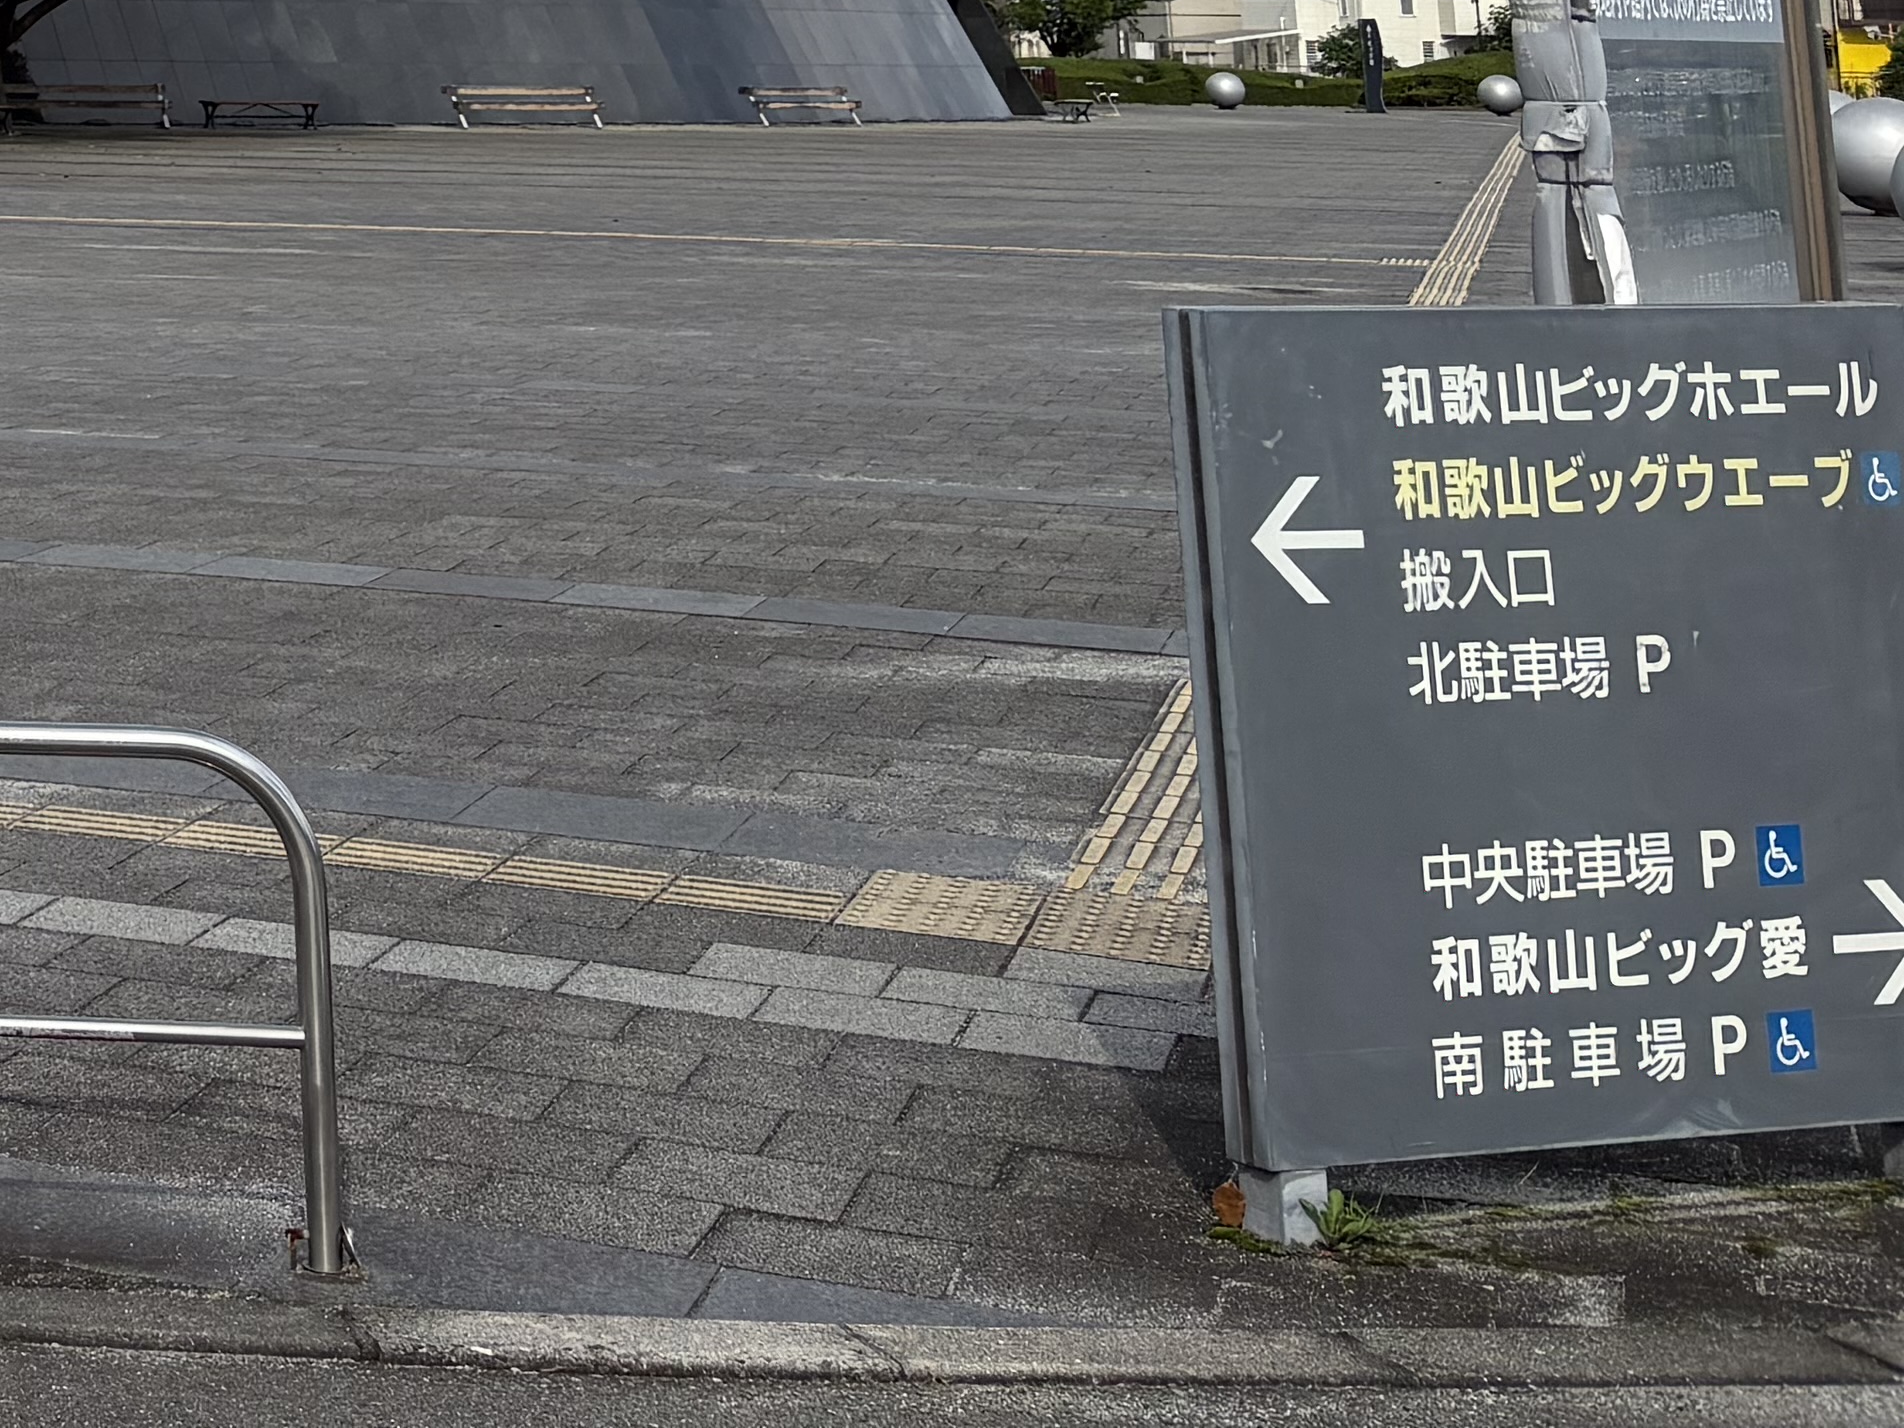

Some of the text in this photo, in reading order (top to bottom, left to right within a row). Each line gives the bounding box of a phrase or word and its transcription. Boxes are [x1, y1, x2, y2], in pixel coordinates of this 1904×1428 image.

[1381, 361, 1878, 427] 和歌山ビッグホエール
[1393, 450, 1852, 520] 和歌山ビッグウエーブ
[1399, 548, 1555, 613] 搬入口
[1407, 634, 1671, 705] 北駐車場 P
[1422, 829, 1737, 909] 中央駐車場 P
[1431, 915, 1810, 1001] 和歌山ビッグ愛
[1431, 1014, 1748, 1099] 南駐車場 P
